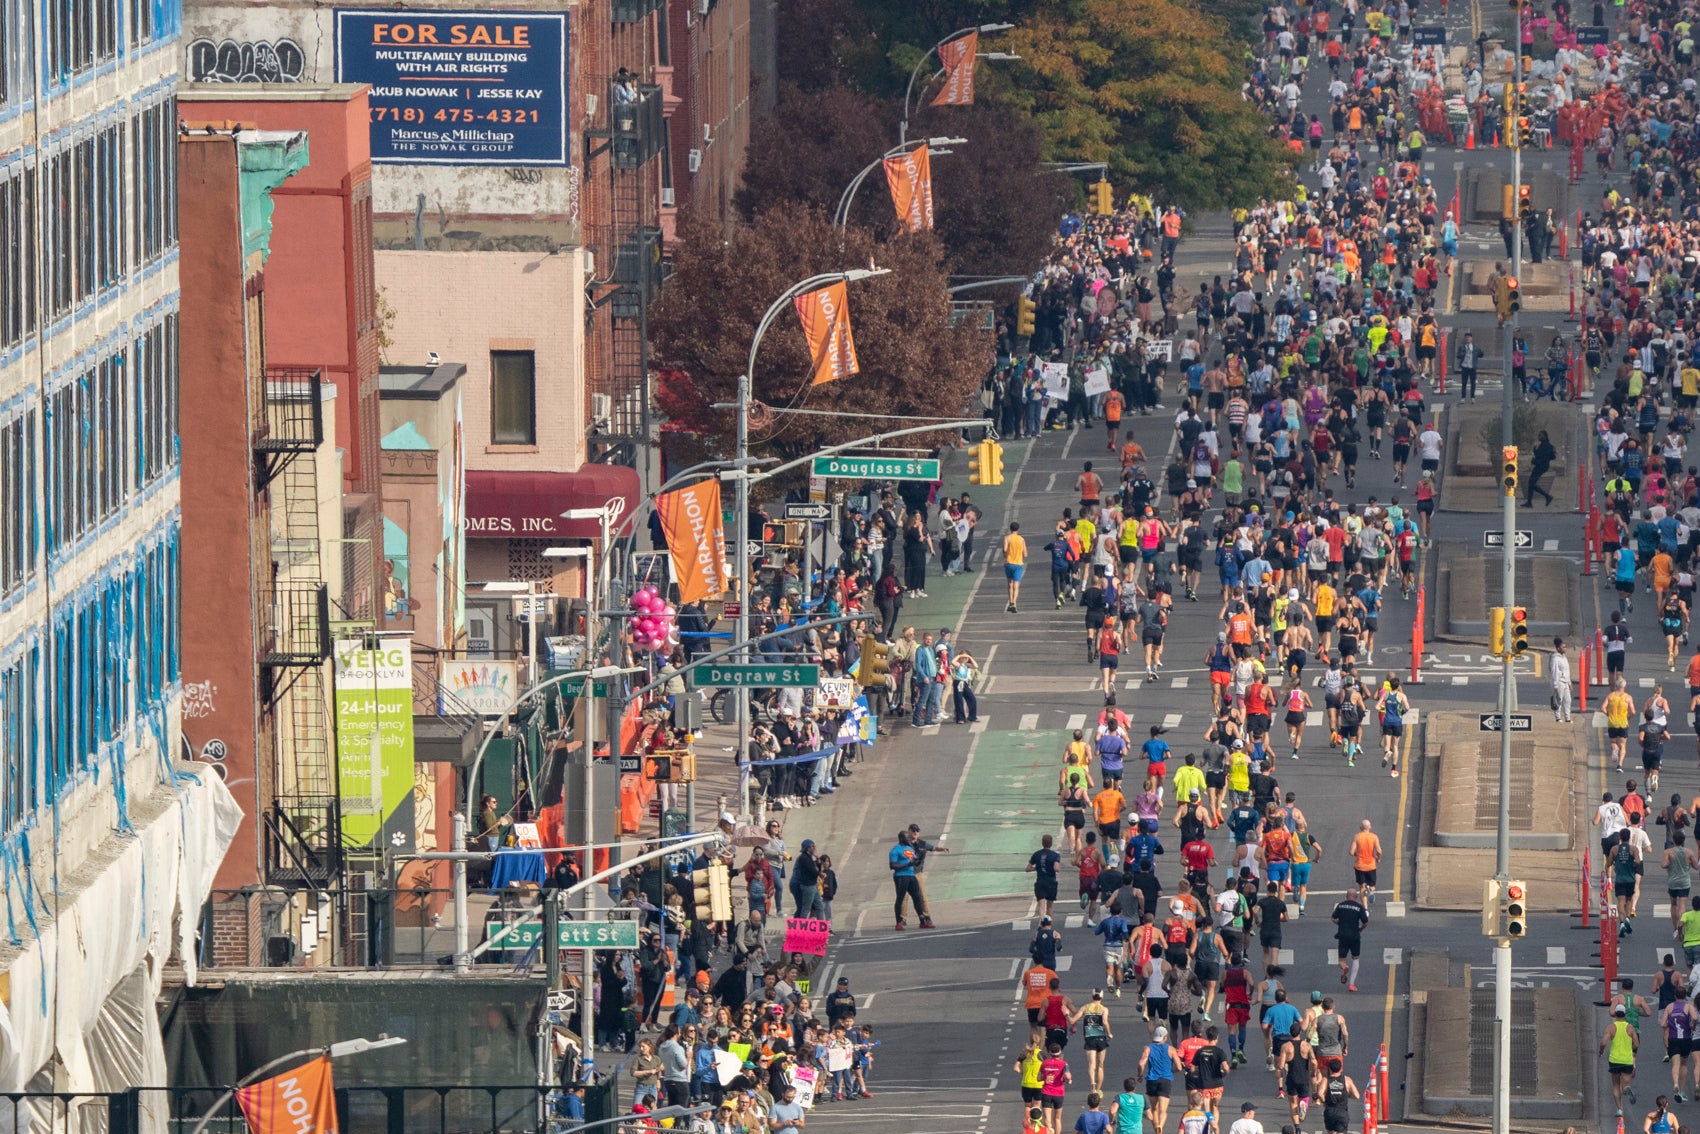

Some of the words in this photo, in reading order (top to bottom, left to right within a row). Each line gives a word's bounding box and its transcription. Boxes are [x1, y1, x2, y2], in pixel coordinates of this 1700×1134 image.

[373, 23, 439, 44] FOR
[450, 24, 530, 45] SALE
[375, 50, 463, 62] MULTIFAMILY
[466, 52, 528, 63] BUILDING
[395, 62, 432, 73] WITH
[434, 63, 458, 73] AIR
[460, 63, 509, 74] RIGHTS
[367, 87, 403, 98] AKUB
[405, 87, 459, 98] NOWAK
[477, 88, 514, 99] JESSE
[515, 88, 543, 99] KAY
[433, 108, 540, 123] 475-4321
[391, 128, 440, 141] Marcus
[452, 129, 515, 143] Millichap
[391, 142, 417, 151] THE
[422, 143, 467, 152] NOWAK
[471, 144, 514, 152] GROUP
[829, 461, 903, 479] Douglass
[905, 462, 924, 475] St
[791, 507, 806, 516] ONE
[461, 517, 515, 533] OMES,
[521, 518, 556, 532] INC.
[681, 488, 720, 594] MARATHON
[338, 648, 404, 669] VERG
[711, 669, 777, 686] Degraw
[781, 669, 800, 682] St
[340, 700, 403, 715] 24-Hour
[340, 719, 405, 734] Emergency
[597, 928, 619, 942] St
[549, 996, 568, 1006] WAY
